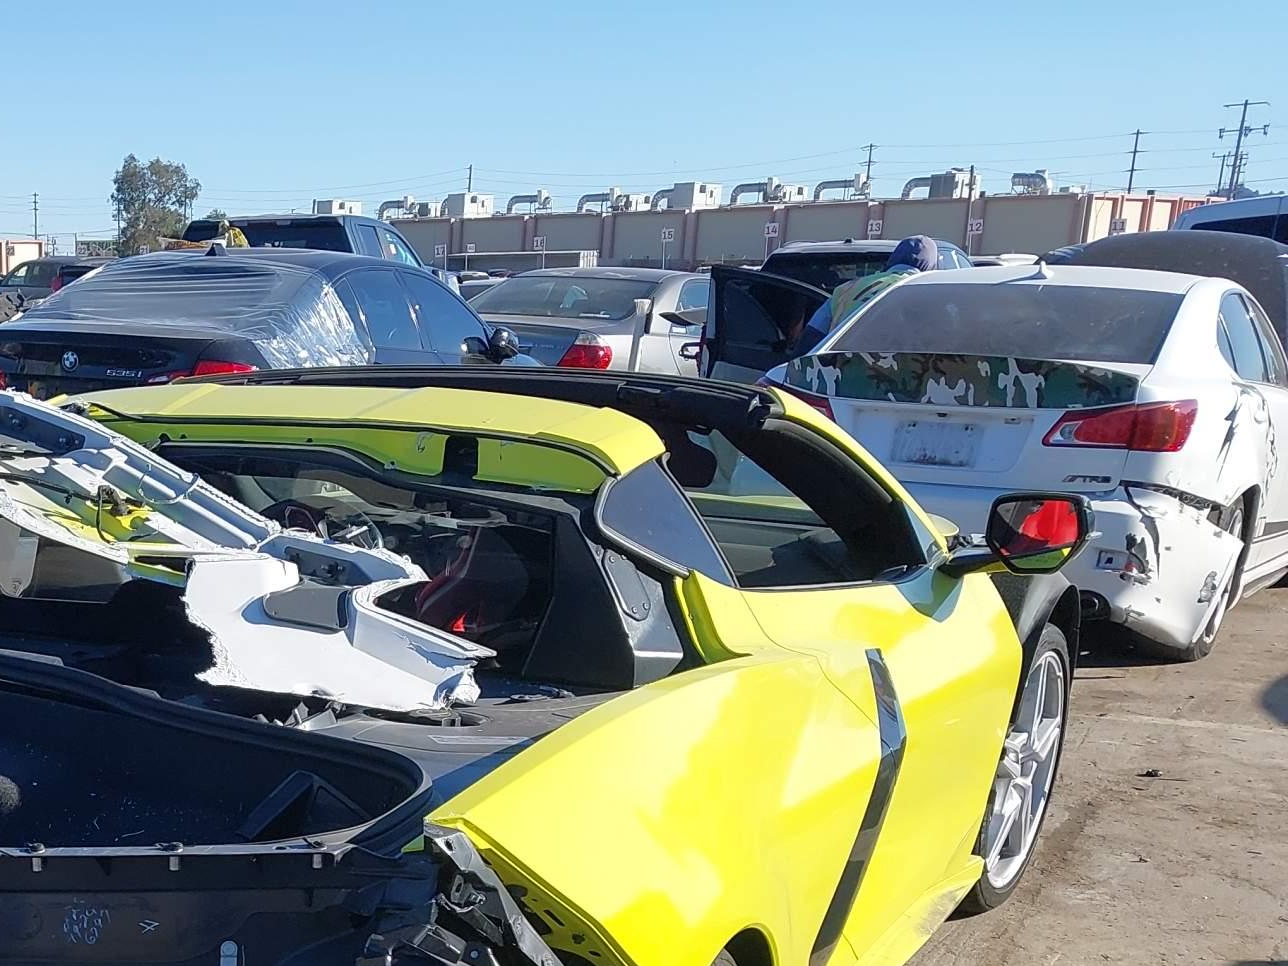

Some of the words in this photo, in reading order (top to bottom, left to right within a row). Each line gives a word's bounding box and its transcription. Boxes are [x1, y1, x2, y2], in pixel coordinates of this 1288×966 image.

[765, 226, 777, 235] 14
[869, 223, 880, 232] 13
[969, 223, 982, 232] 12
[1112, 221, 1125, 231] 11
[662, 231, 673, 240] 15
